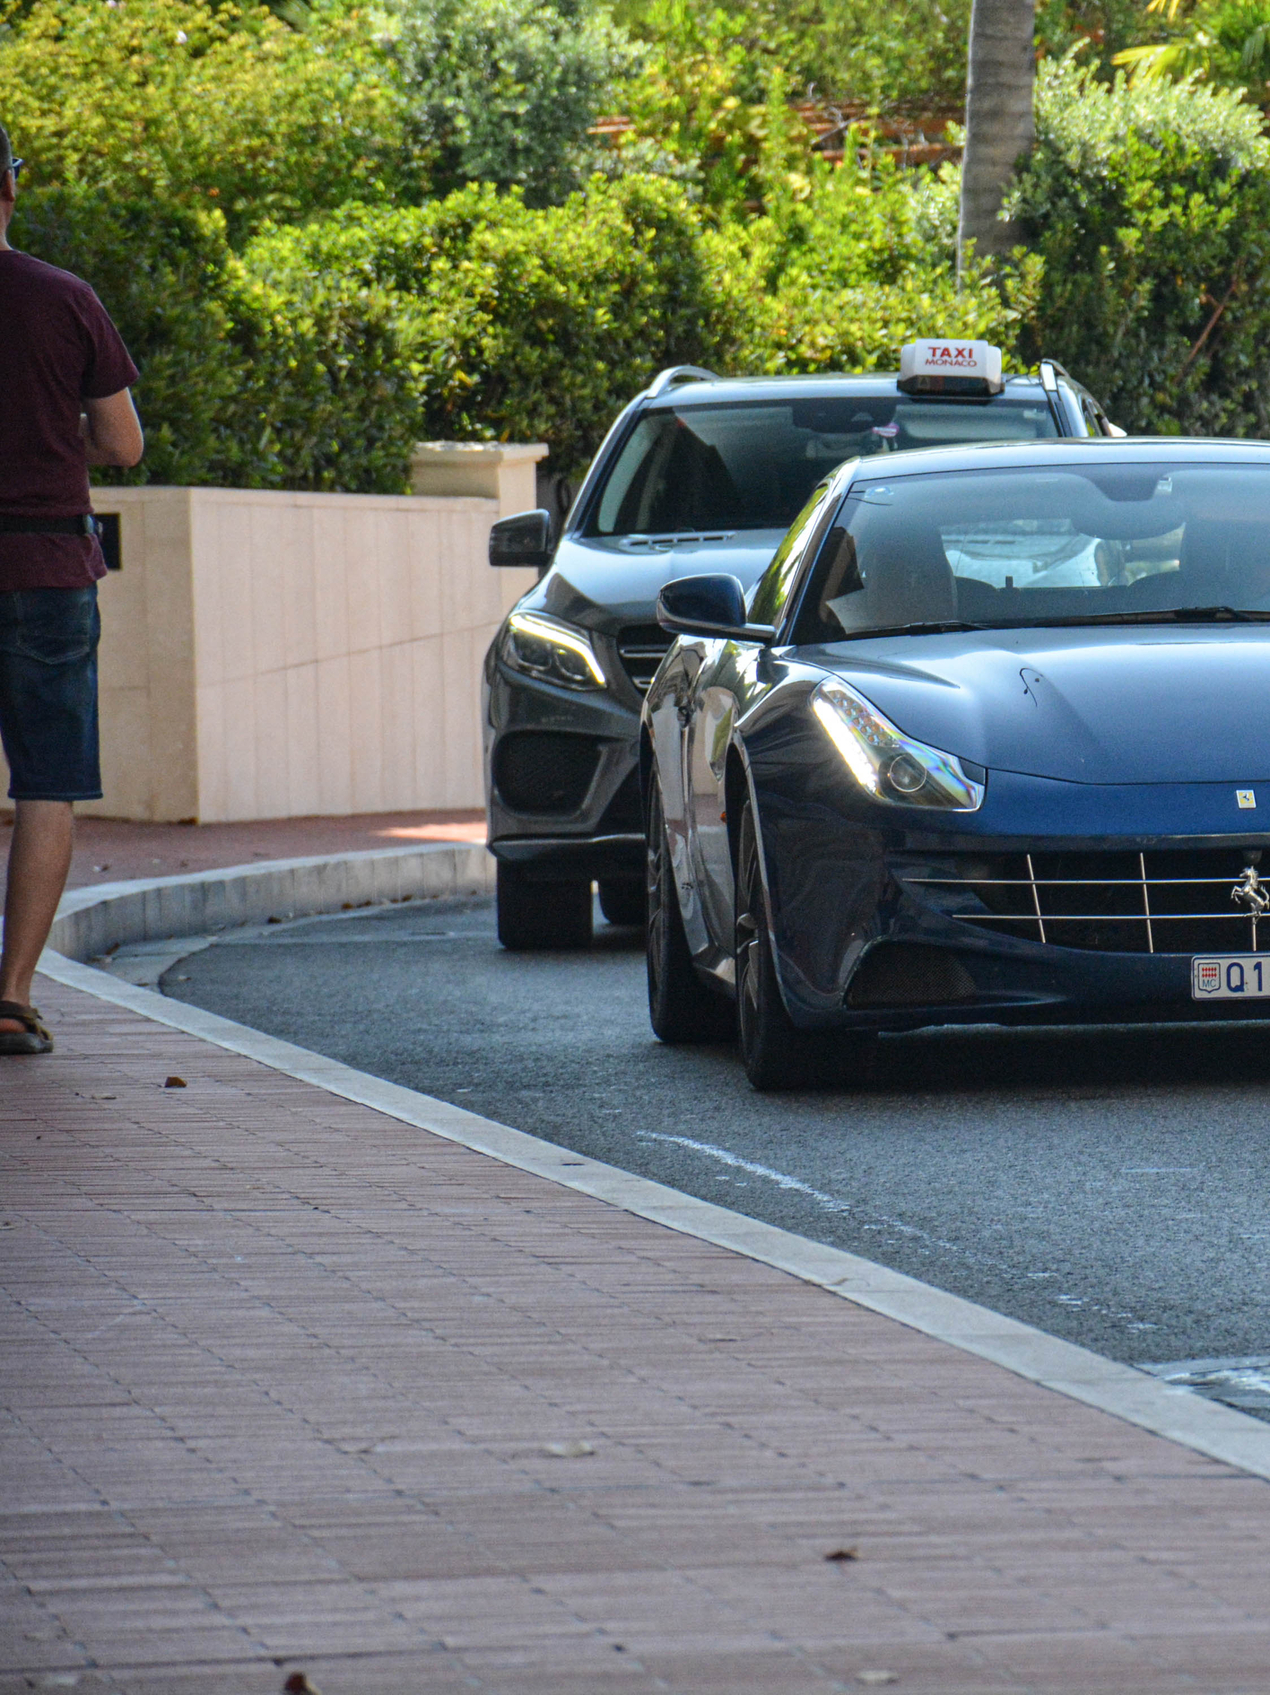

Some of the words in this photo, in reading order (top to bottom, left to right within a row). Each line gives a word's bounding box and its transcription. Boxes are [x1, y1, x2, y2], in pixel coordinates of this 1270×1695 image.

[928, 347, 973, 358] TAXI
[925, 358, 977, 367] MONACO
[1202, 979, 1217, 988] MC
